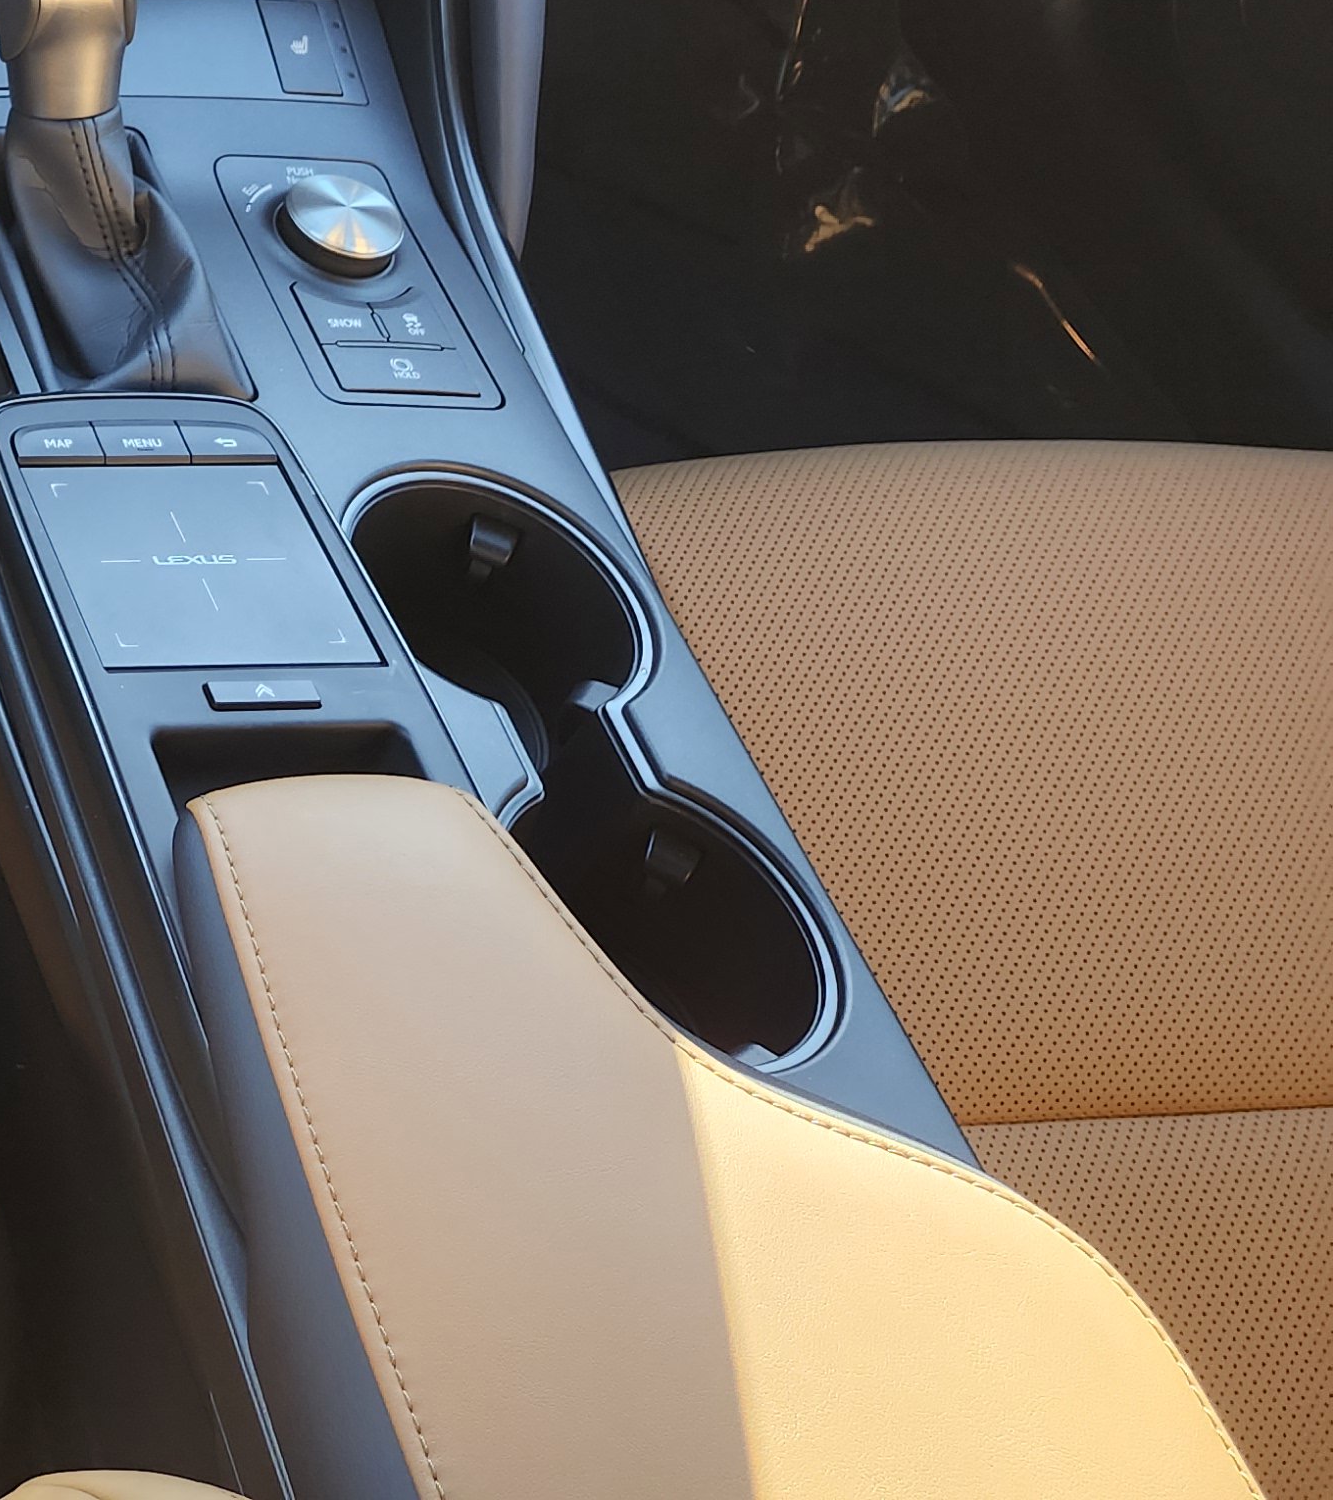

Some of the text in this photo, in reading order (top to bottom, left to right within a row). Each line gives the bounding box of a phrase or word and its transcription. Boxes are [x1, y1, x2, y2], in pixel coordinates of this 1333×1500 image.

[286, 166, 314, 177] PUSH
[327, 318, 362, 329] SNOW
[393, 370, 421, 380] HOLD
[44, 437, 73, 449] MAP
[122, 437, 163, 449] MENU
[152, 555, 238, 566] LEXUS
